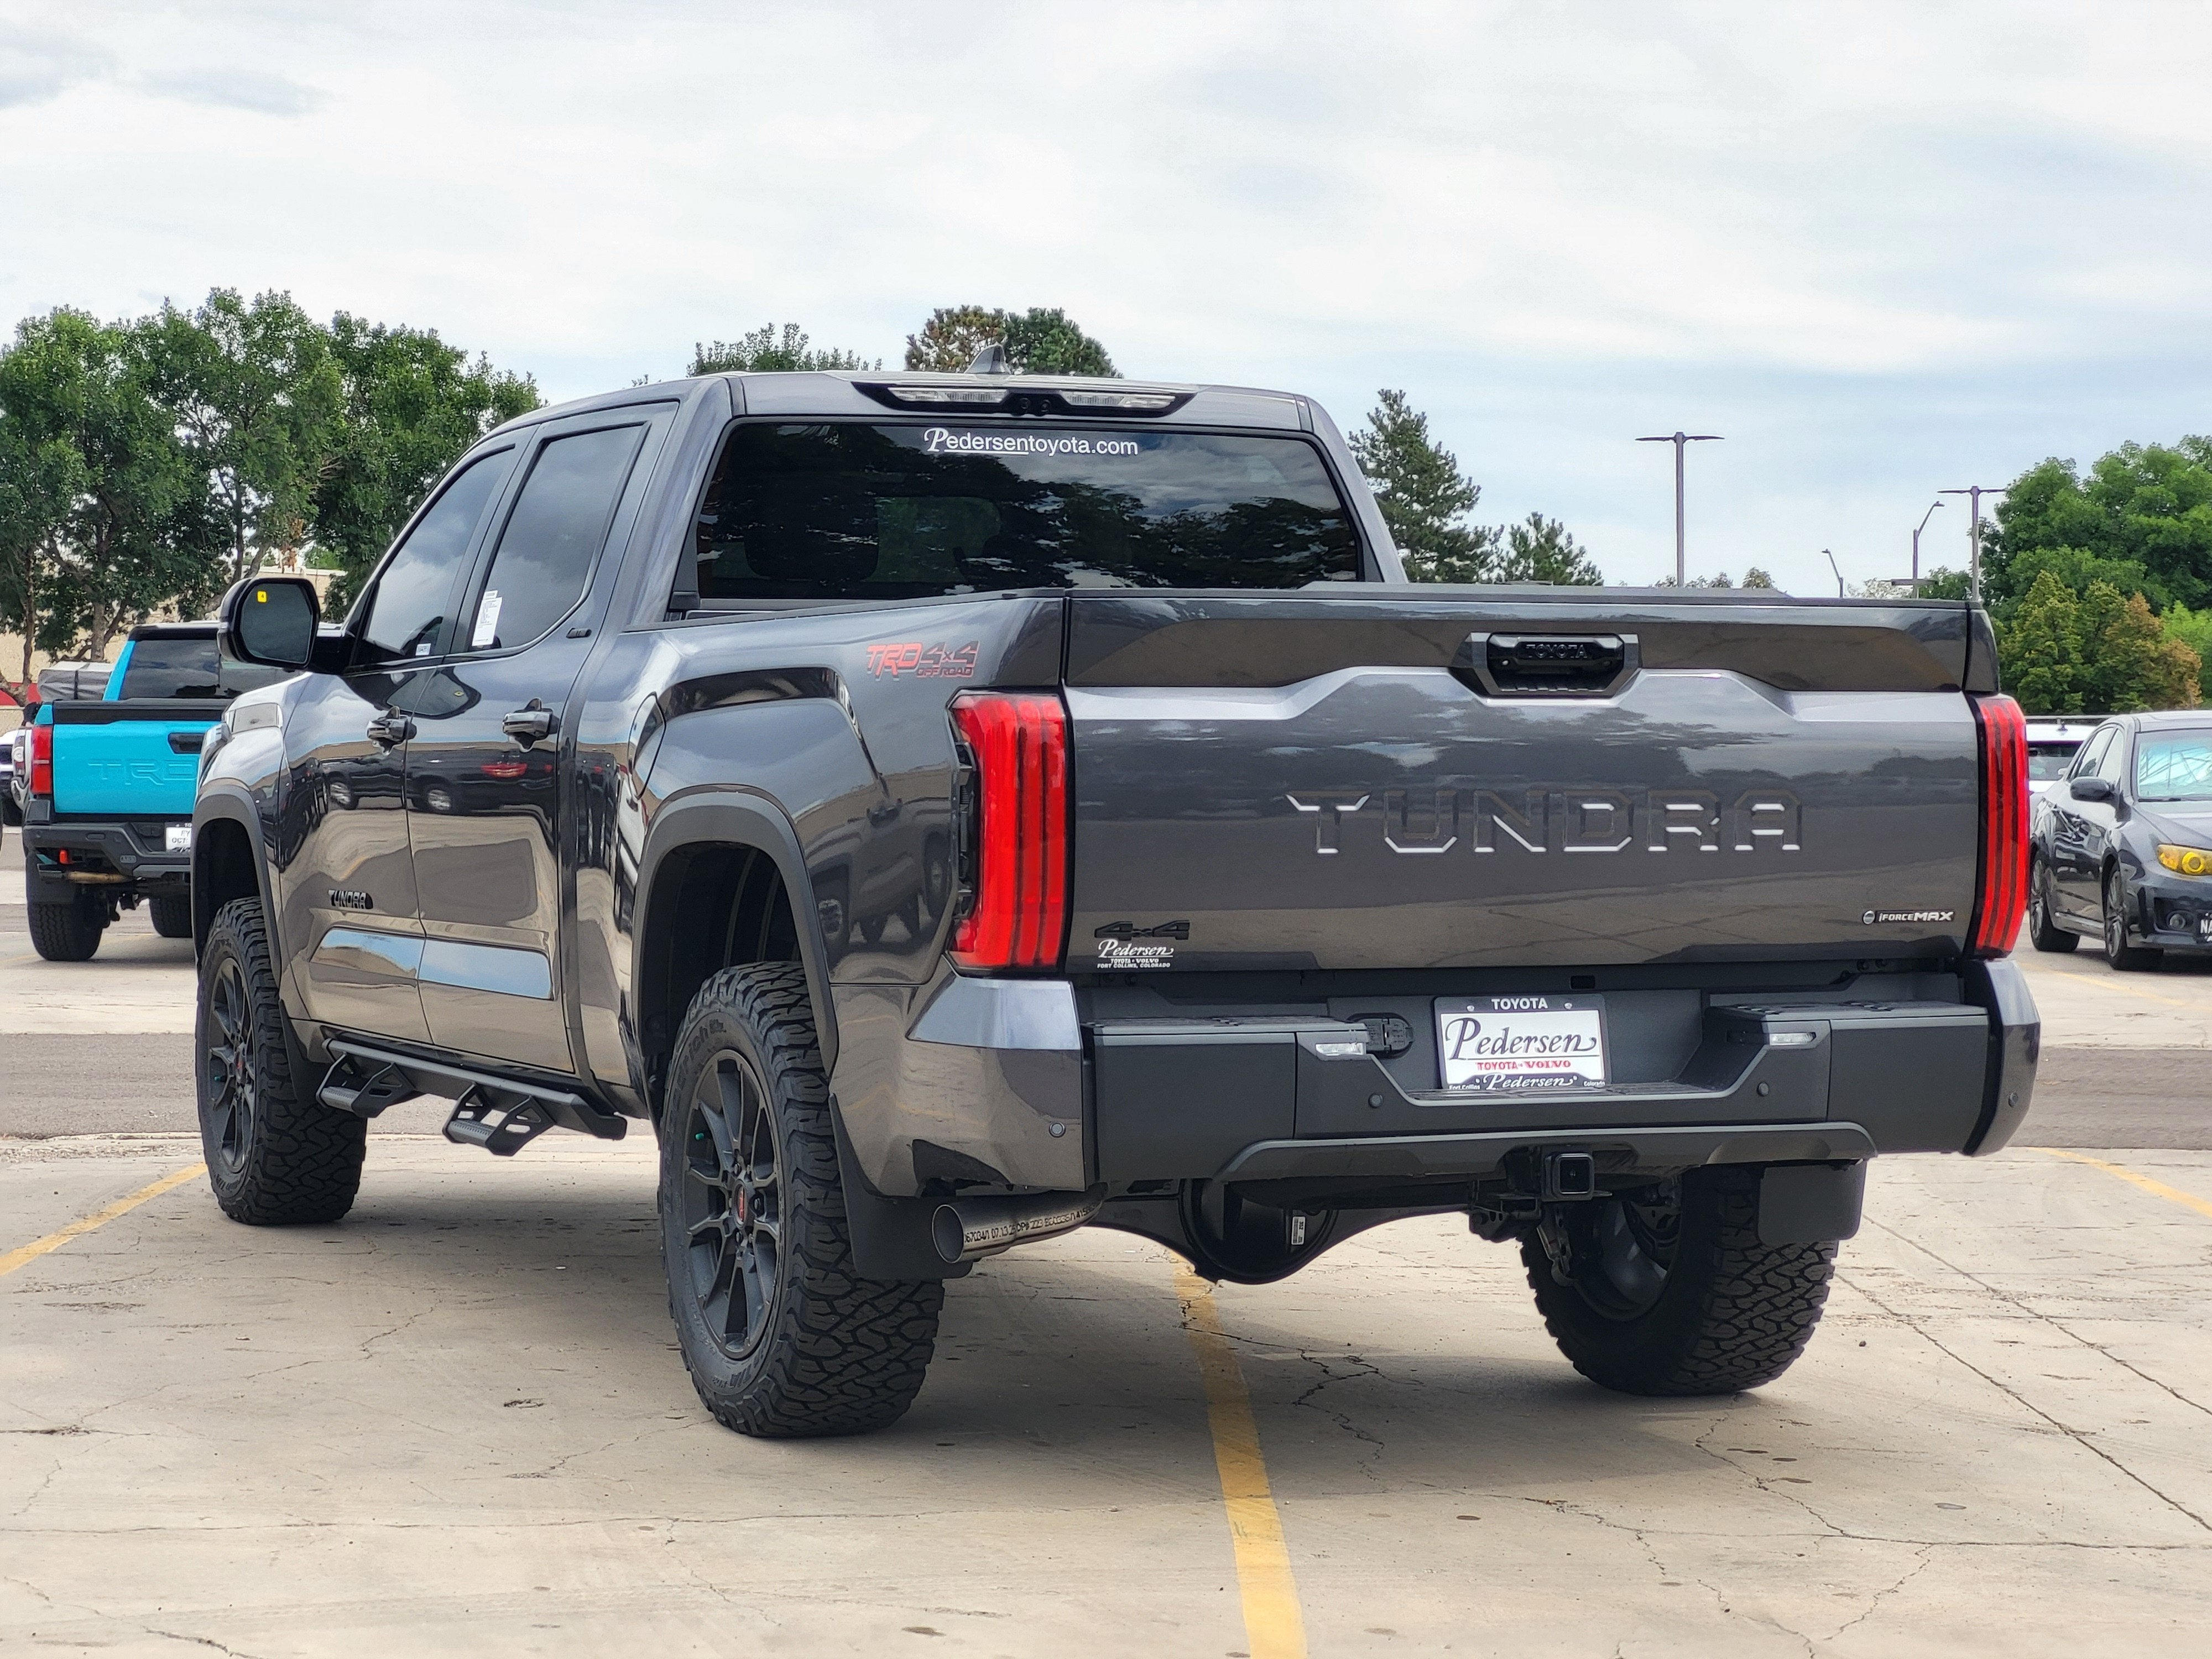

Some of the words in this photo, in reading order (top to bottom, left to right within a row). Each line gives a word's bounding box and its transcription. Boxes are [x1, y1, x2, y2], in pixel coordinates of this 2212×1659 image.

[924, 427, 1138, 457] Pedersentoyota.com
[867, 642, 922, 681] TRD
[920, 641, 980, 668] 4x4
[1526, 643, 1588, 659] TOYOTA
[917, 667, 939, 678] OFF
[941, 667, 974, 678] ROAD
[1285, 790, 1802, 854] TUNDRA
[328, 889, 367, 910] TUNDRA
[1094, 920, 1190, 941] 4x4
[1098, 938, 1175, 958] Pedersen
[1491, 998, 1548, 1010] TOYOTA
[1445, 1018, 1597, 1060] Pedersen
[1477, 1061, 1518, 1071] TOYOTA
[1524, 1060, 1572, 1069] VOLVO
[1482, 1073, 1574, 1090] Pedersen
